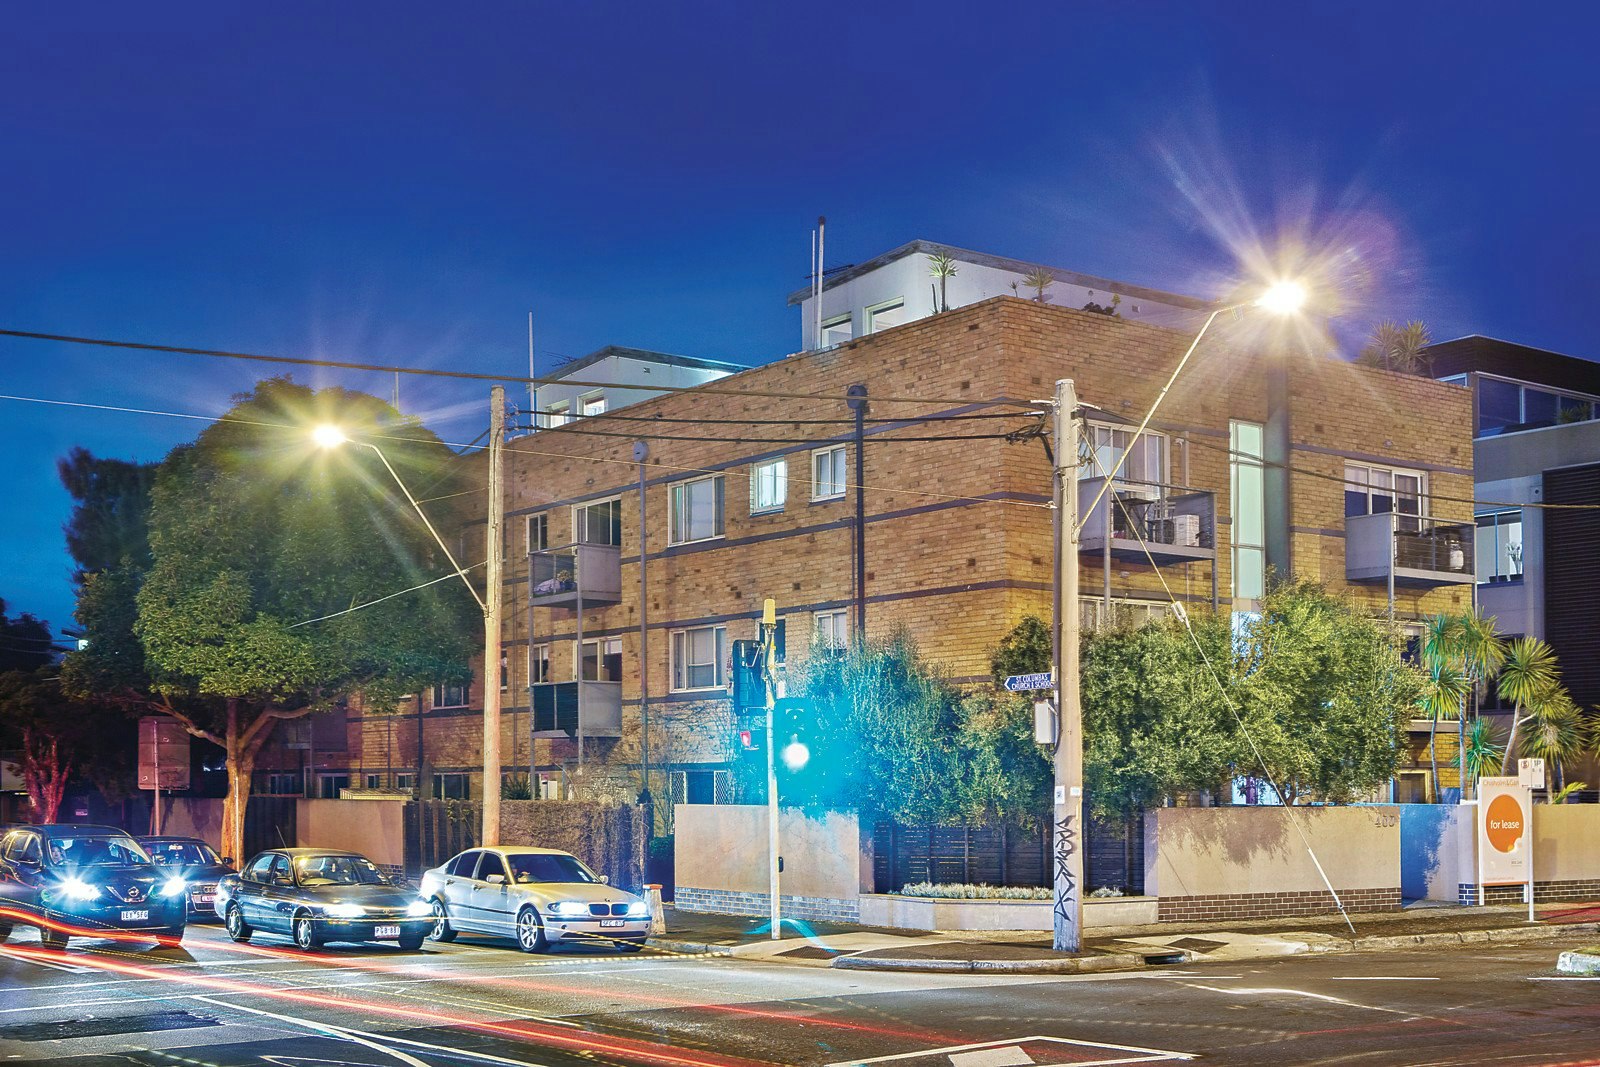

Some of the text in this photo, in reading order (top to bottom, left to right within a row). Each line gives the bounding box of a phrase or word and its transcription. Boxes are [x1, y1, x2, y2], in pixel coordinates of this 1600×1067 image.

[1011, 682, 1030, 690] CHURCH
[1490, 820, 1520, 829] for lease
